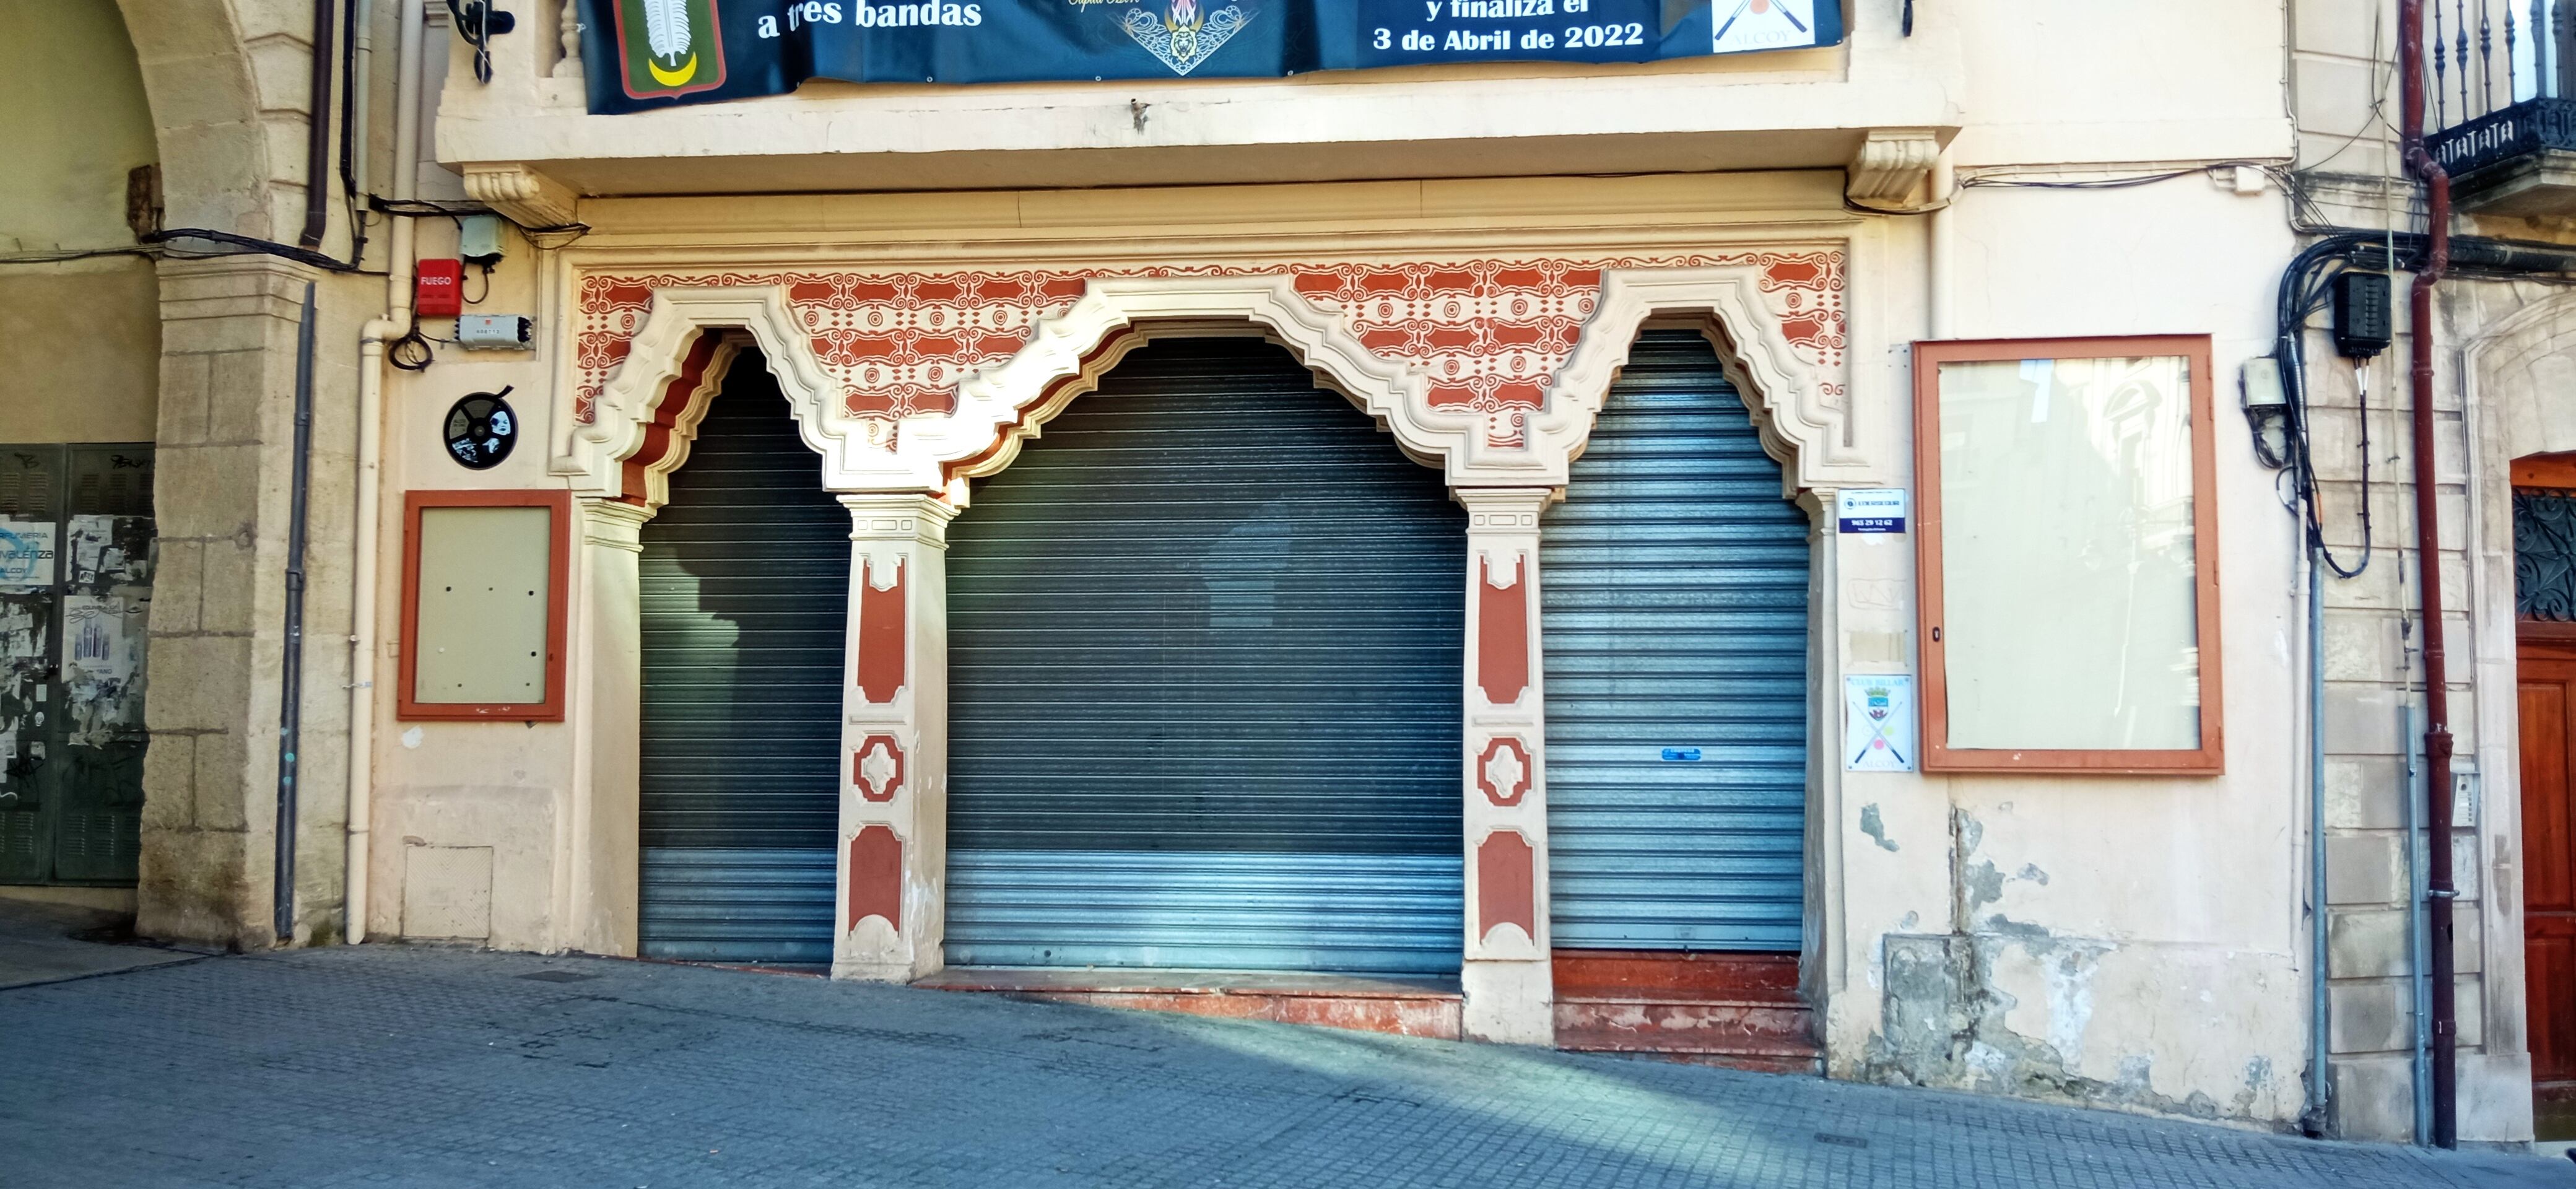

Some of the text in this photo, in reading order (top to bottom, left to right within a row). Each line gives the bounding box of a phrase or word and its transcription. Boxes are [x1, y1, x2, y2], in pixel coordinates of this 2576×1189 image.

[758, 0, 981, 38] a tres bandas
[1426, 0, 1588, 22] y finaliza el
[1373, 23, 1643, 51] 3 de Abril de 2022
[1730, 30, 1790, 45] ALCOY
[420, 276, 451, 285] FUEGO
